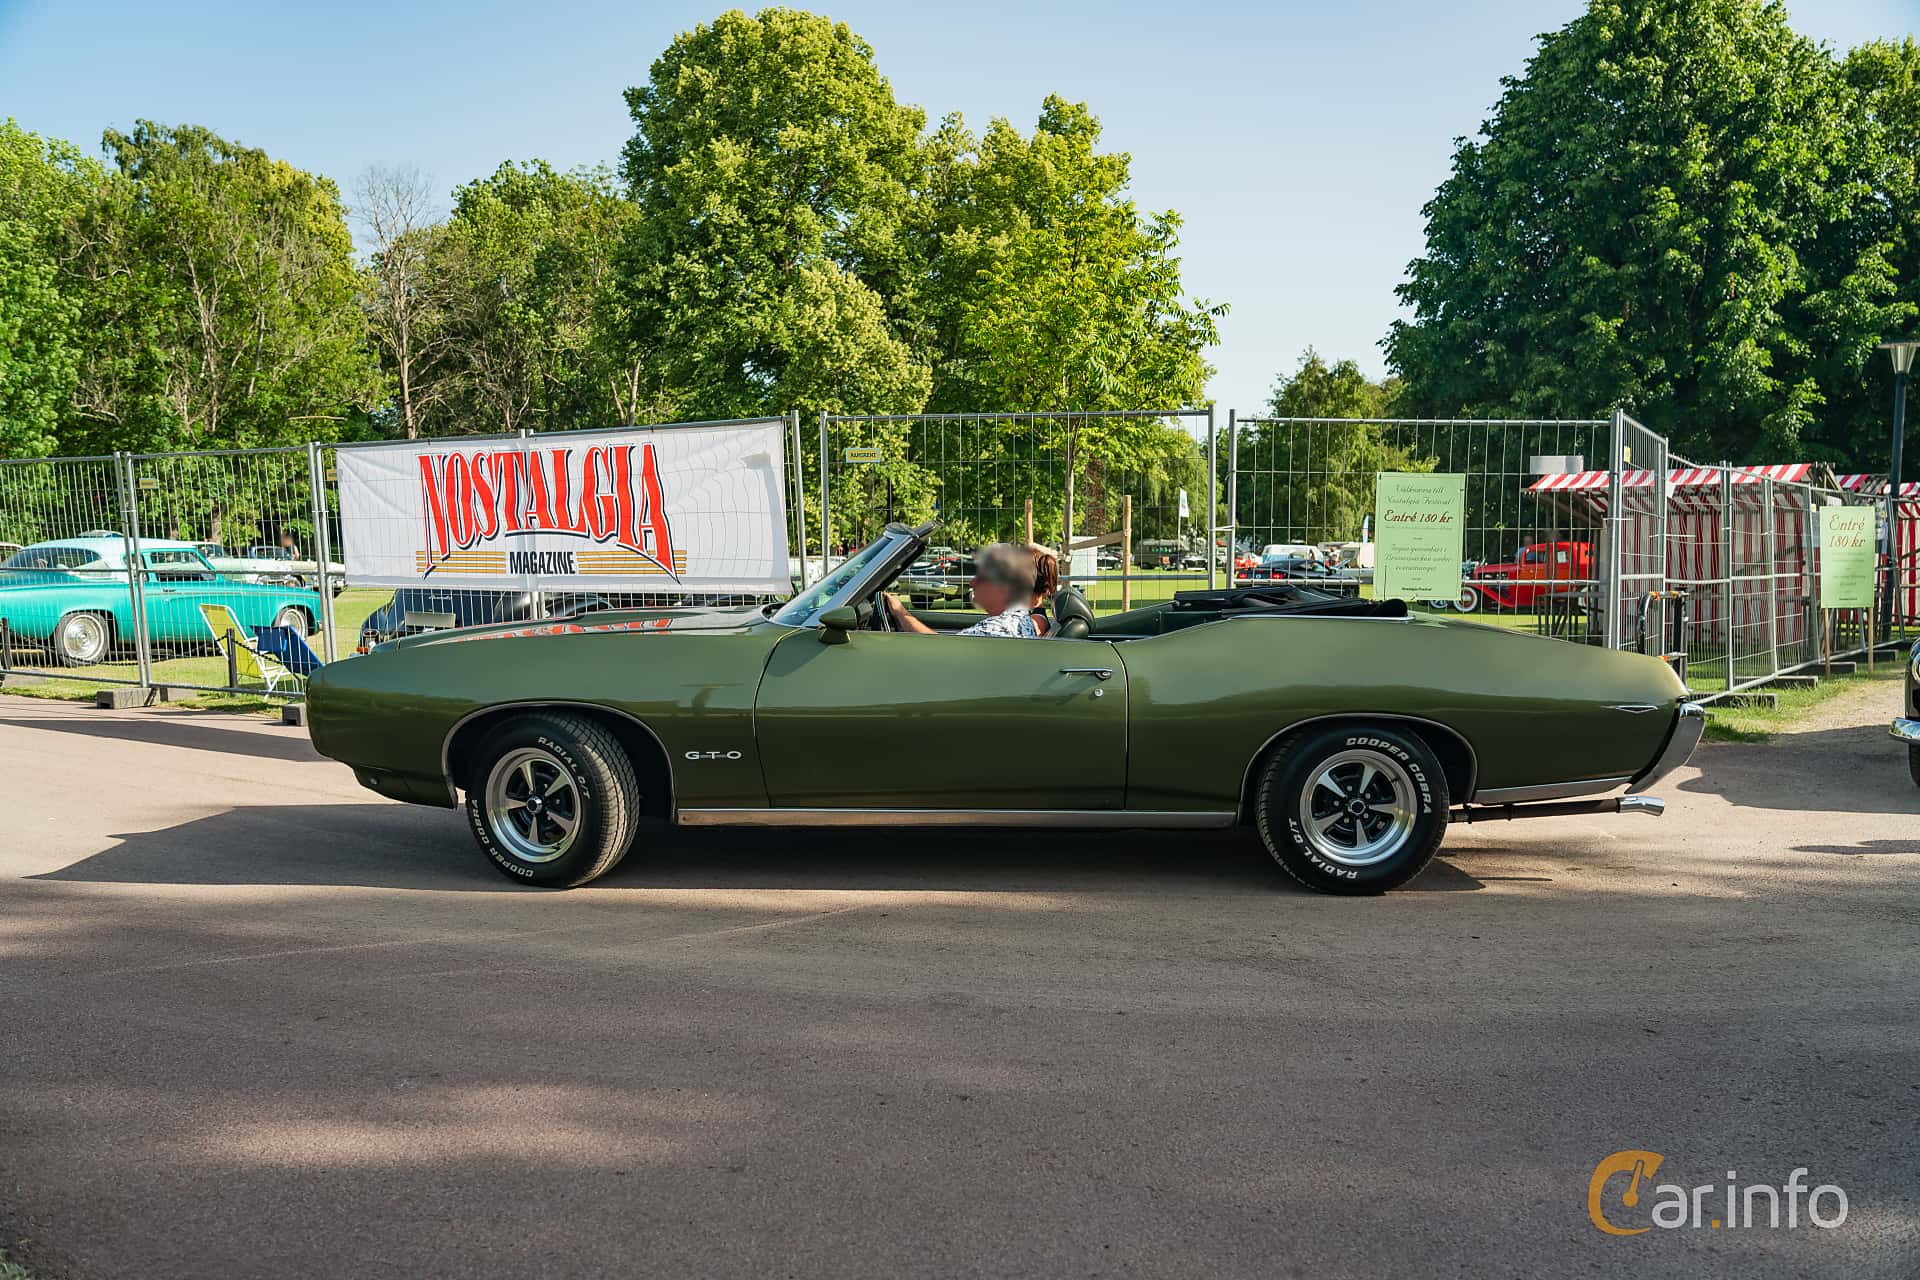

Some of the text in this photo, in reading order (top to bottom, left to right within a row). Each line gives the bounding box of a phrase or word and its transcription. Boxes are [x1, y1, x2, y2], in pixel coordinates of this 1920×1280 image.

[416, 443, 681, 584] NOSTALGIA
[1384, 509, 1454, 523] Entré 180 kr
[1829, 513, 1865, 531] Entré
[1829, 532, 1866, 547] 180 kr
[509, 551, 576, 575] MAGAZINE
[537, 736, 578, 772] RADIAL
[1346, 737, 1432, 814] COOPER COBRA
[471, 799, 534, 878] COOPER COBRA
[1304, 845, 1359, 879] RADIAL
